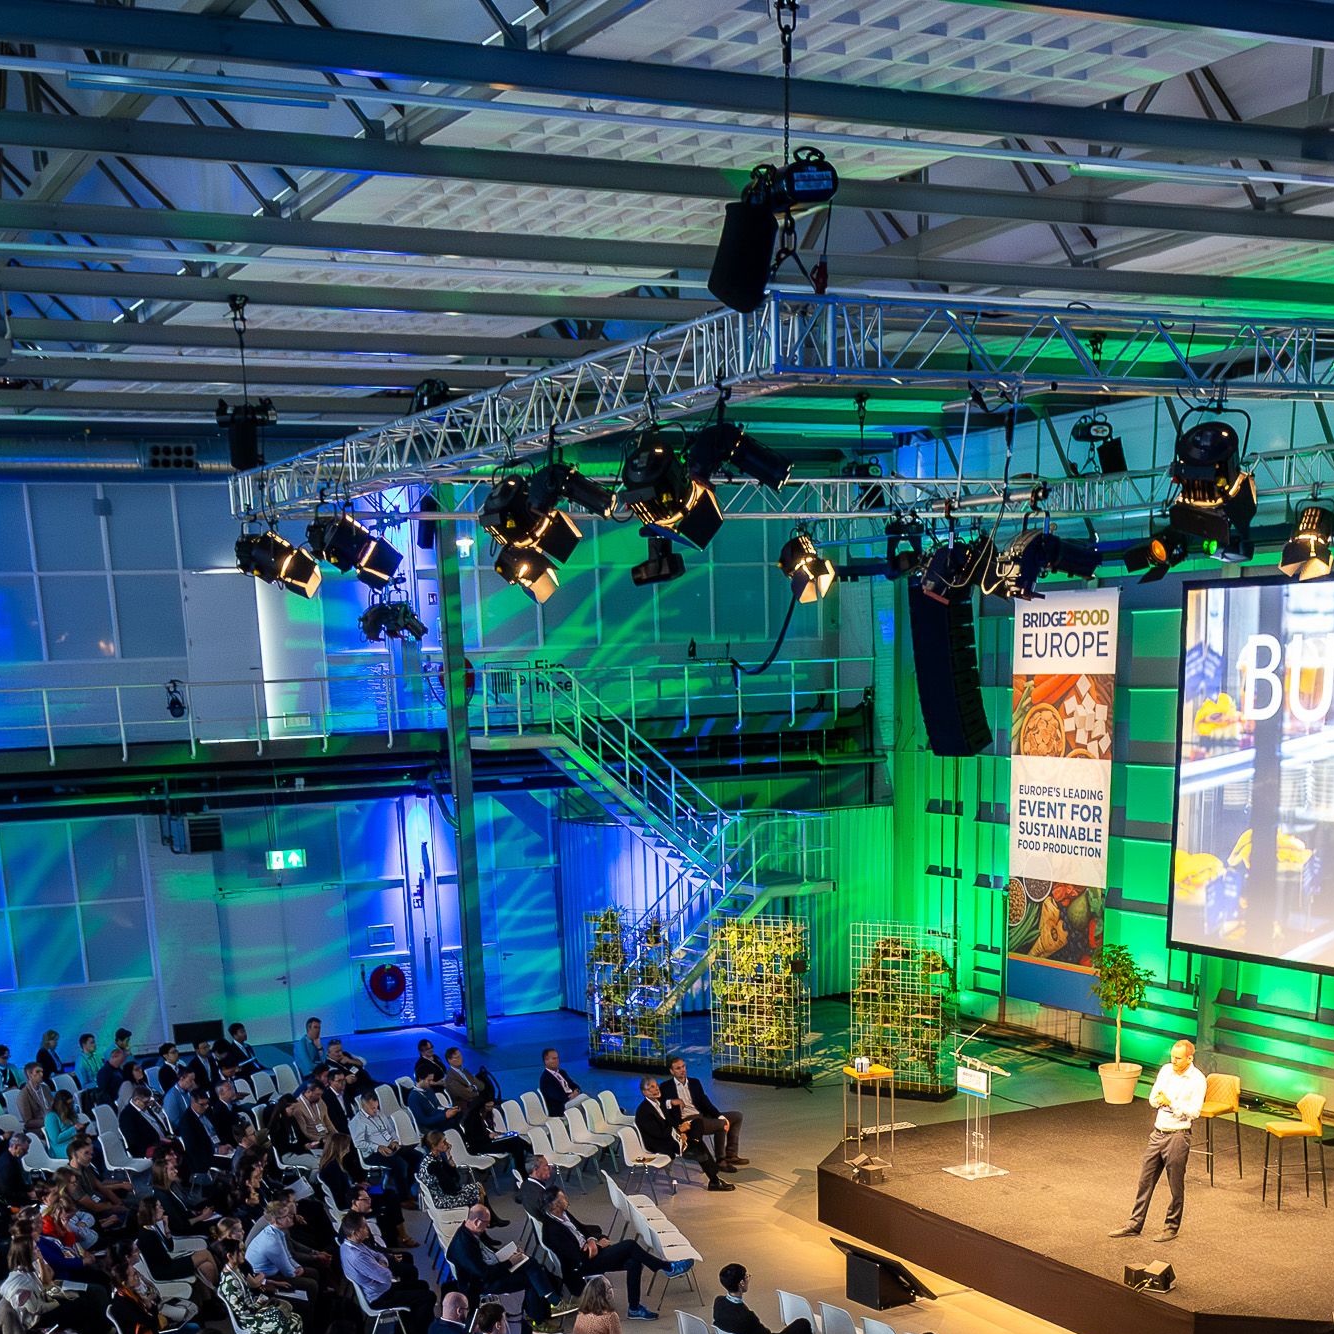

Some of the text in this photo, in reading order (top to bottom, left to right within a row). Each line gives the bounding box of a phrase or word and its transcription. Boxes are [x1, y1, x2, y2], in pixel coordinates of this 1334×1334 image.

[1022, 609, 1110, 628] BRIDGE2FOOD
[1022, 631, 1109, 658] EUROPE
[1019, 784, 1104, 801] EUROPE'S LEADING
[1019, 799, 1102, 823] EVENT FOR
[1018, 821, 1102, 843] SUSTAINABLE
[1017, 839, 1101, 858] FOOD PRODUCTION
